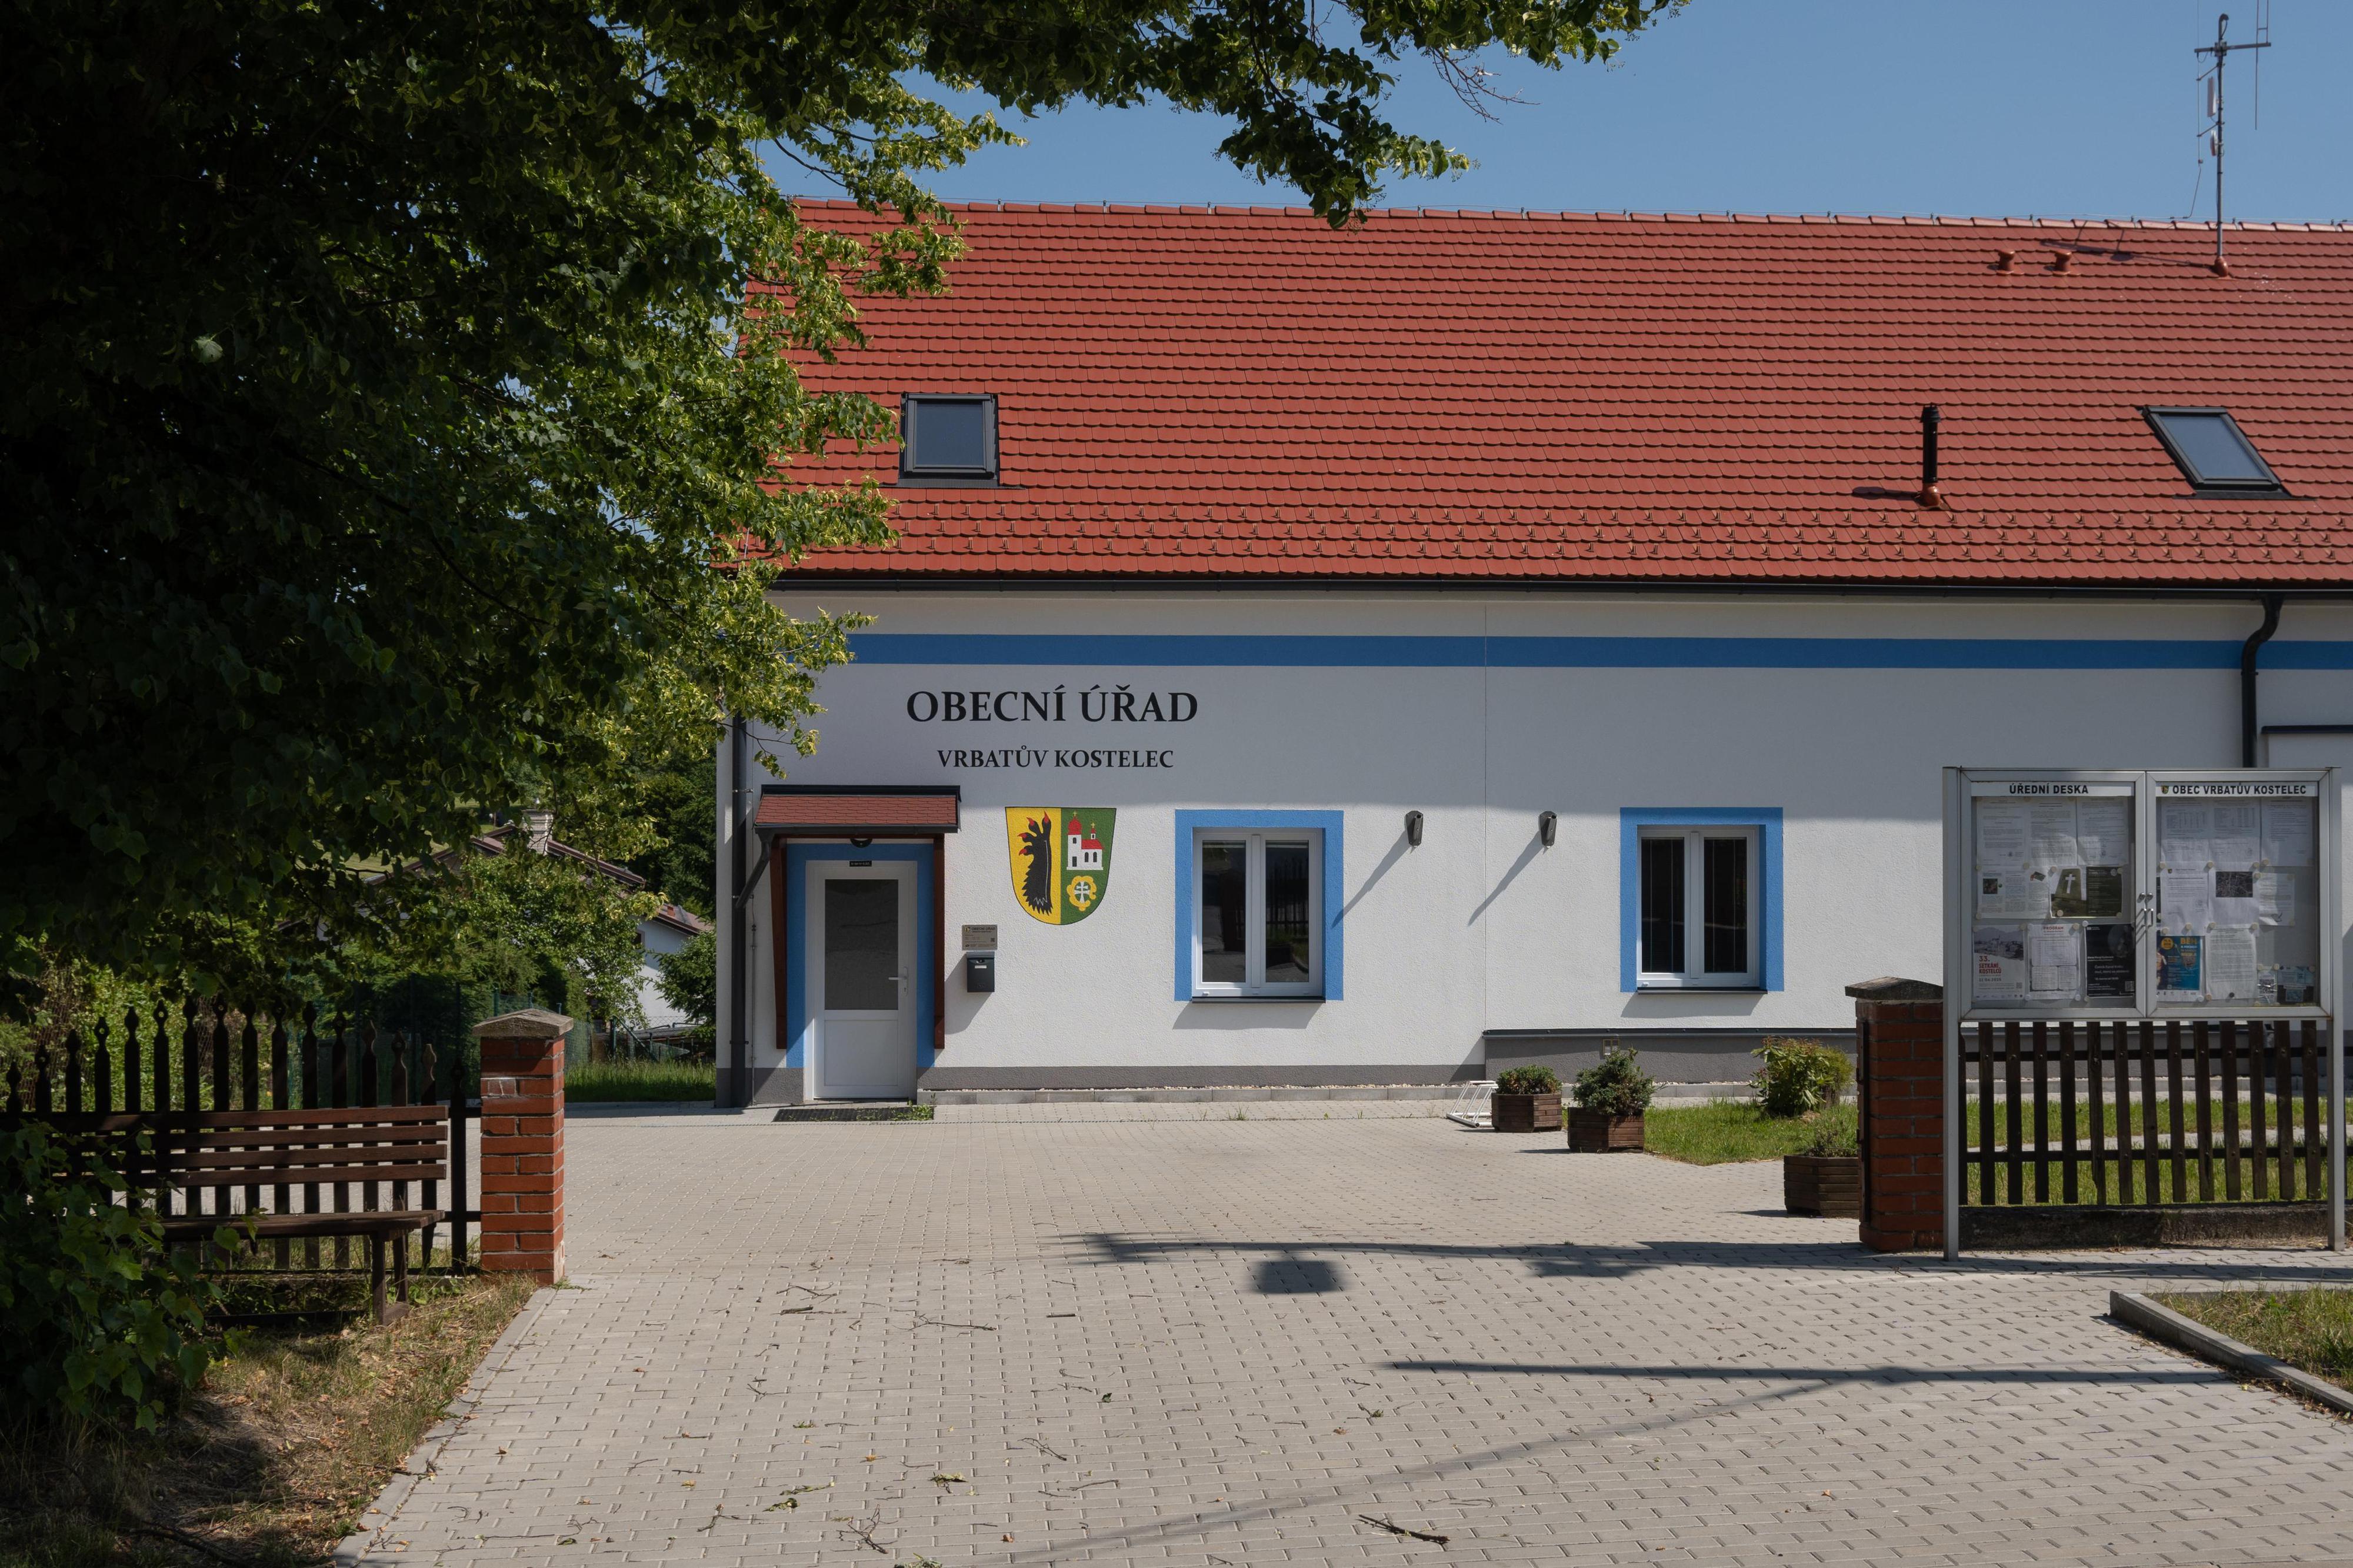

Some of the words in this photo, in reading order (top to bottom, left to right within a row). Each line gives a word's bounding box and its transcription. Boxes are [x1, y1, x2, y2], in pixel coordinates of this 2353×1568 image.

[906, 684, 1066, 722] OBECNÍ
[1078, 684, 1198, 722] ÚŘAD
[937, 745, 1049, 768] VRBATŮV
[1054, 749, 1174, 768] KOSTELEC
[2009, 783, 2049, 794] ÚŘEDNÍ
[2053, 785, 2089, 794] DESKA
[2172, 785, 2200, 795] OBEC
[2203, 783, 2251, 795] VRBATŮV
[2254, 785, 2307, 794] KOSTELEC
